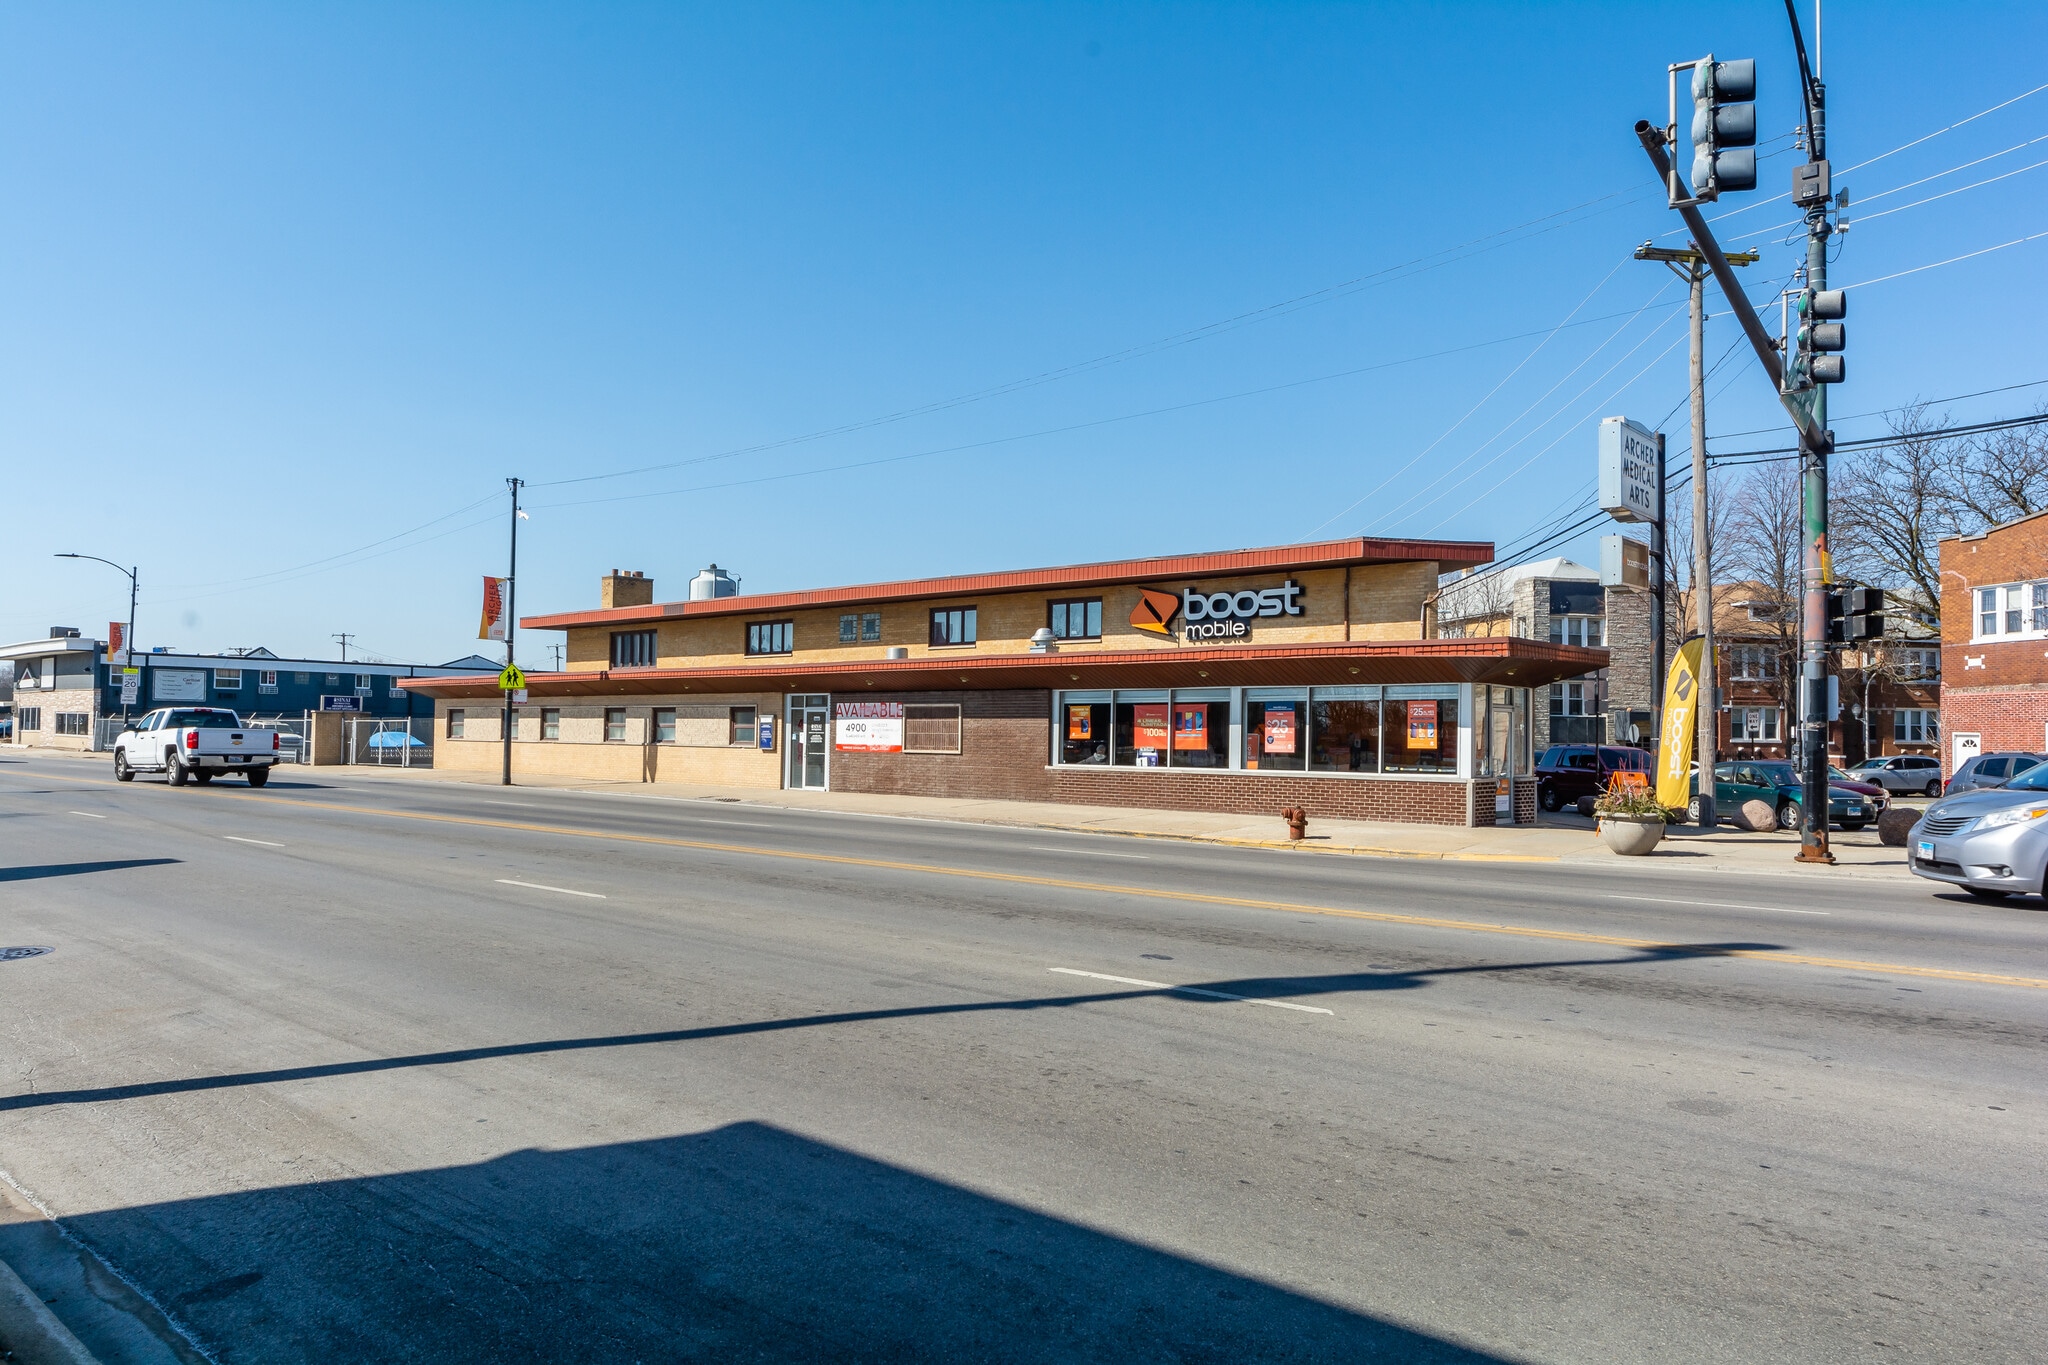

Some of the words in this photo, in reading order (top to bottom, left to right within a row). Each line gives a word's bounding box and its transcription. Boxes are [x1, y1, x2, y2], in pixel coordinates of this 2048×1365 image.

[1624, 435, 1655, 466] ARCHER
[1623, 457, 1656, 489] MEDICAL
[1629, 483, 1650, 509] ARTS
[1183, 580, 1300, 620] boost
[1185, 620, 1246, 638] mobile
[835, 702, 903, 718] AVAILABLE
[845, 723, 867, 732] 4900
[1143, 728, 1159, 737] $100
[1266, 719, 1289, 734] $25
[1664, 708, 1674, 747] mobile
[1668, 707, 1689, 780] boost
